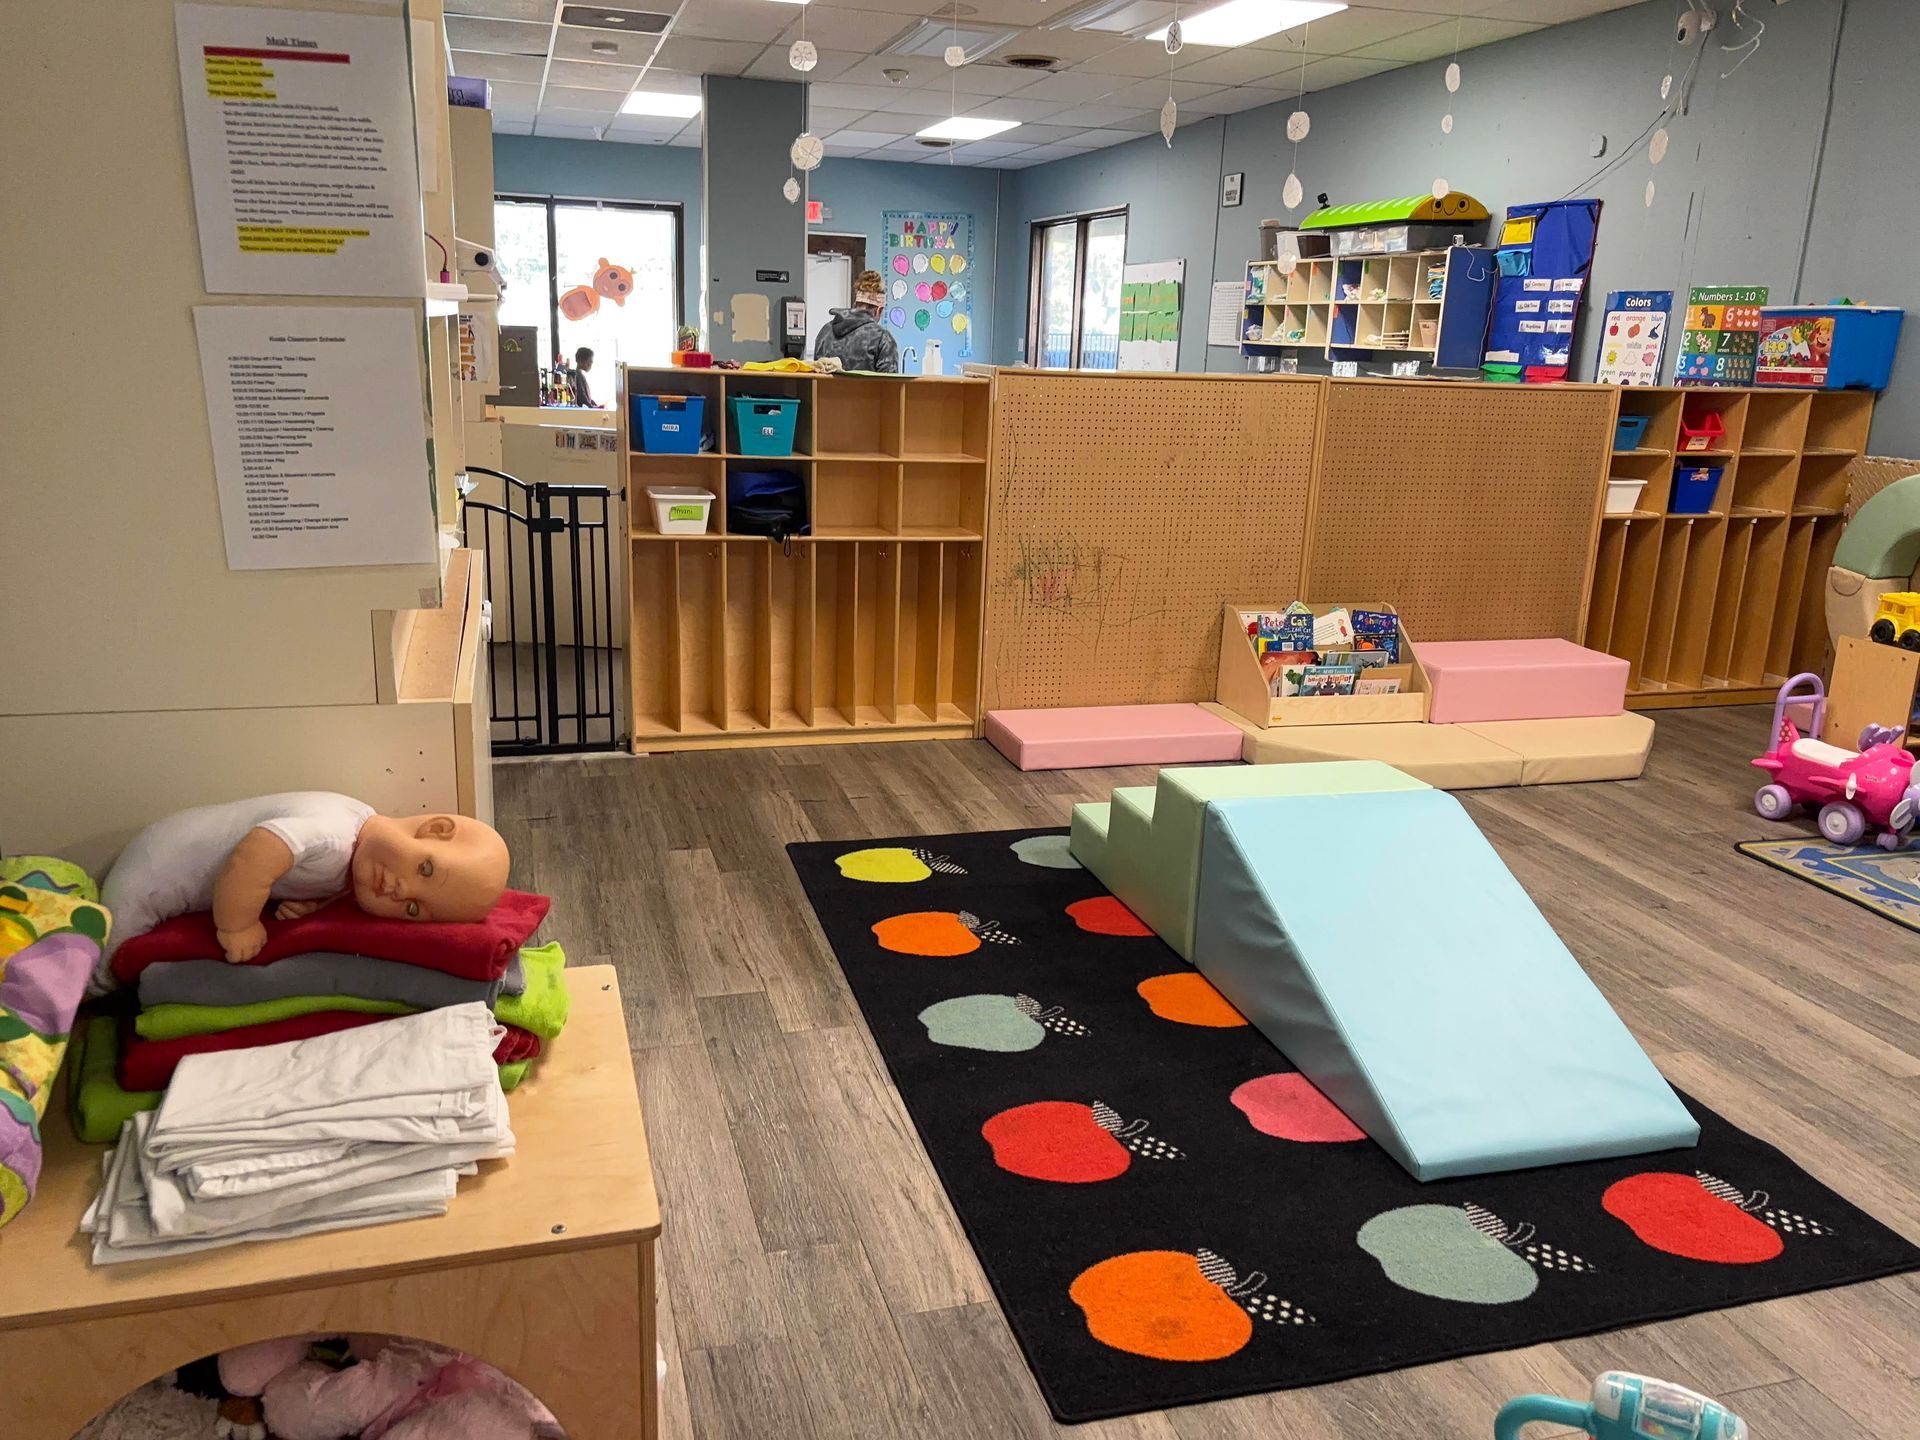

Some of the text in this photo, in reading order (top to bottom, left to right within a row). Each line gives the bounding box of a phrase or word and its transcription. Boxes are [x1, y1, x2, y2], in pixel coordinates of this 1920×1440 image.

[266, 36, 318, 49] Meal Times
[904, 221, 959, 236] HAPPY
[1698, 292, 1733, 301] Numbers
[1625, 297, 1652, 307] Colors
[1688, 307, 1735, 322] 1 6
[1626, 316, 1646, 324] orange
[1684, 332, 1730, 347] 2 7
[1646, 343, 1657, 351] pink
[1679, 356, 1725, 371] 3 8
[1600, 369, 1615, 377] green
[1640, 371, 1652, 379] grey
[1265, 616, 1284, 627] Pete
[1291, 616, 1307, 626] Cat
